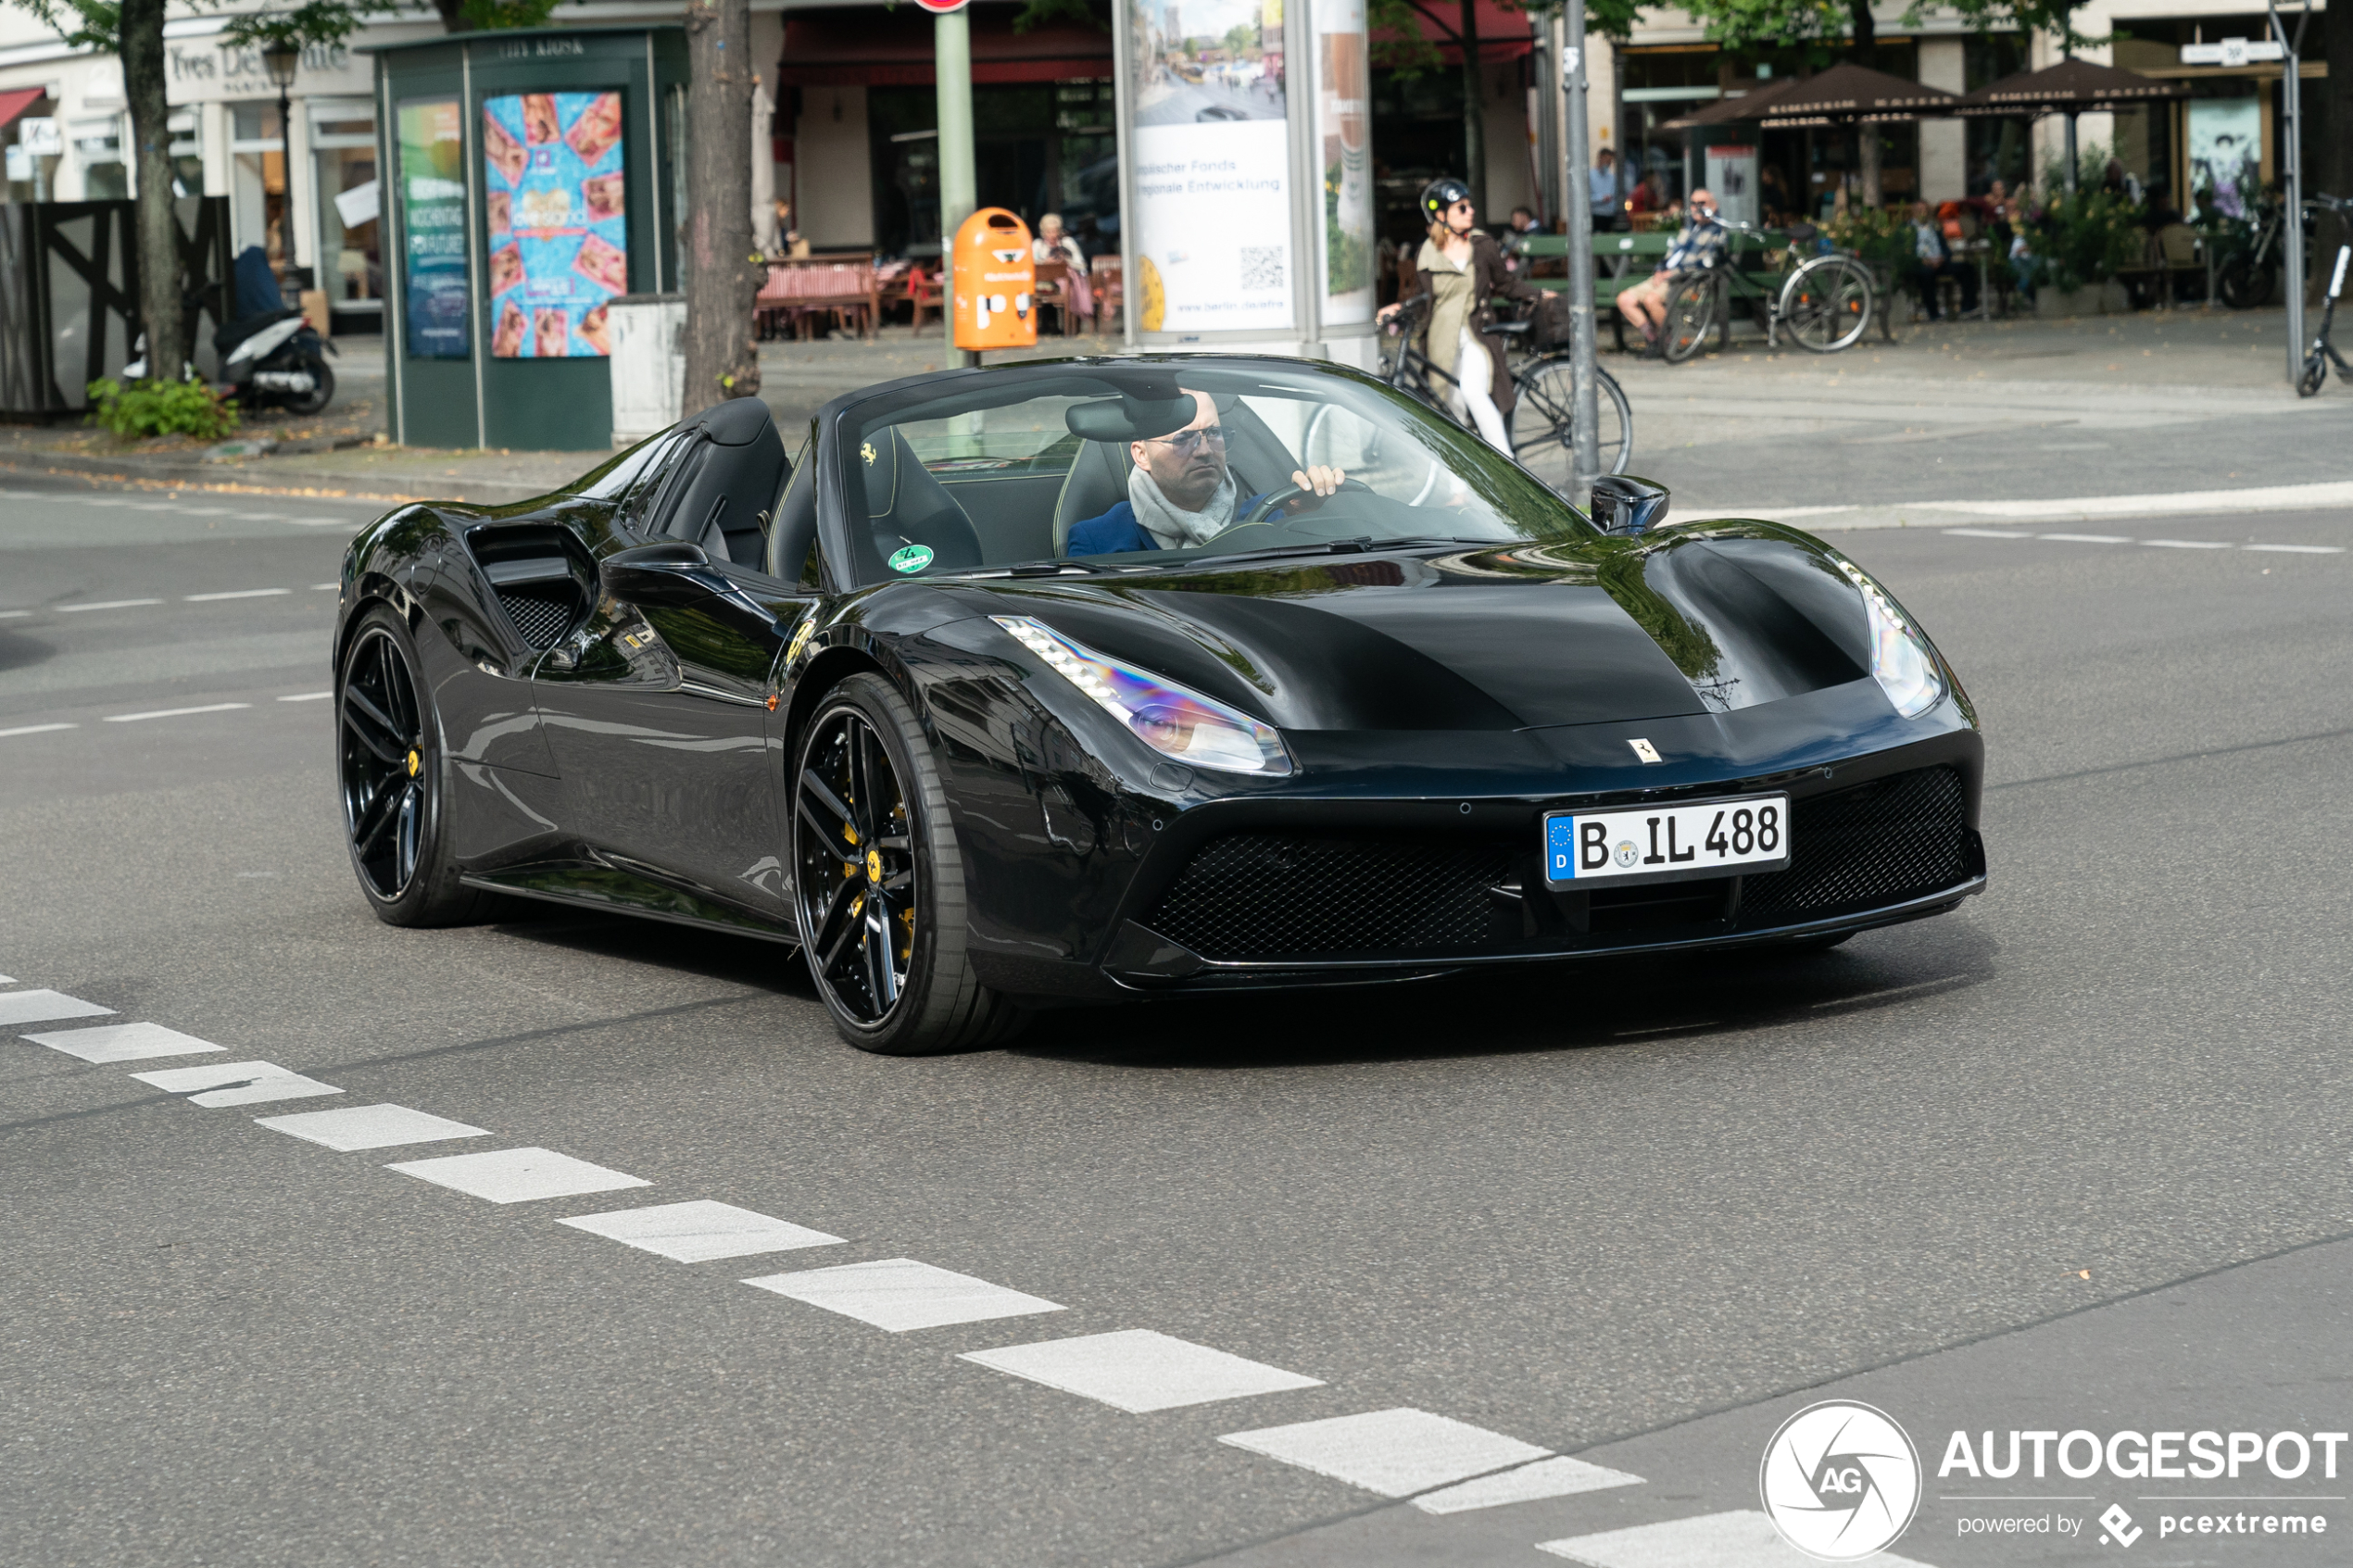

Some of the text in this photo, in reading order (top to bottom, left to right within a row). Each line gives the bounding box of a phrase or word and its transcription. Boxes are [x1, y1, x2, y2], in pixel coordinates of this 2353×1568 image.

[1191, 160, 1237, 172] Fonds
[1188, 179, 1280, 193] Entwicklung
[904, 548, 916, 559] 4
[1580, 822, 1609, 870] B
[1643, 816, 1694, 864] IL
[1705, 806, 1779, 858] 488
[1556, 854, 1567, 868] D
